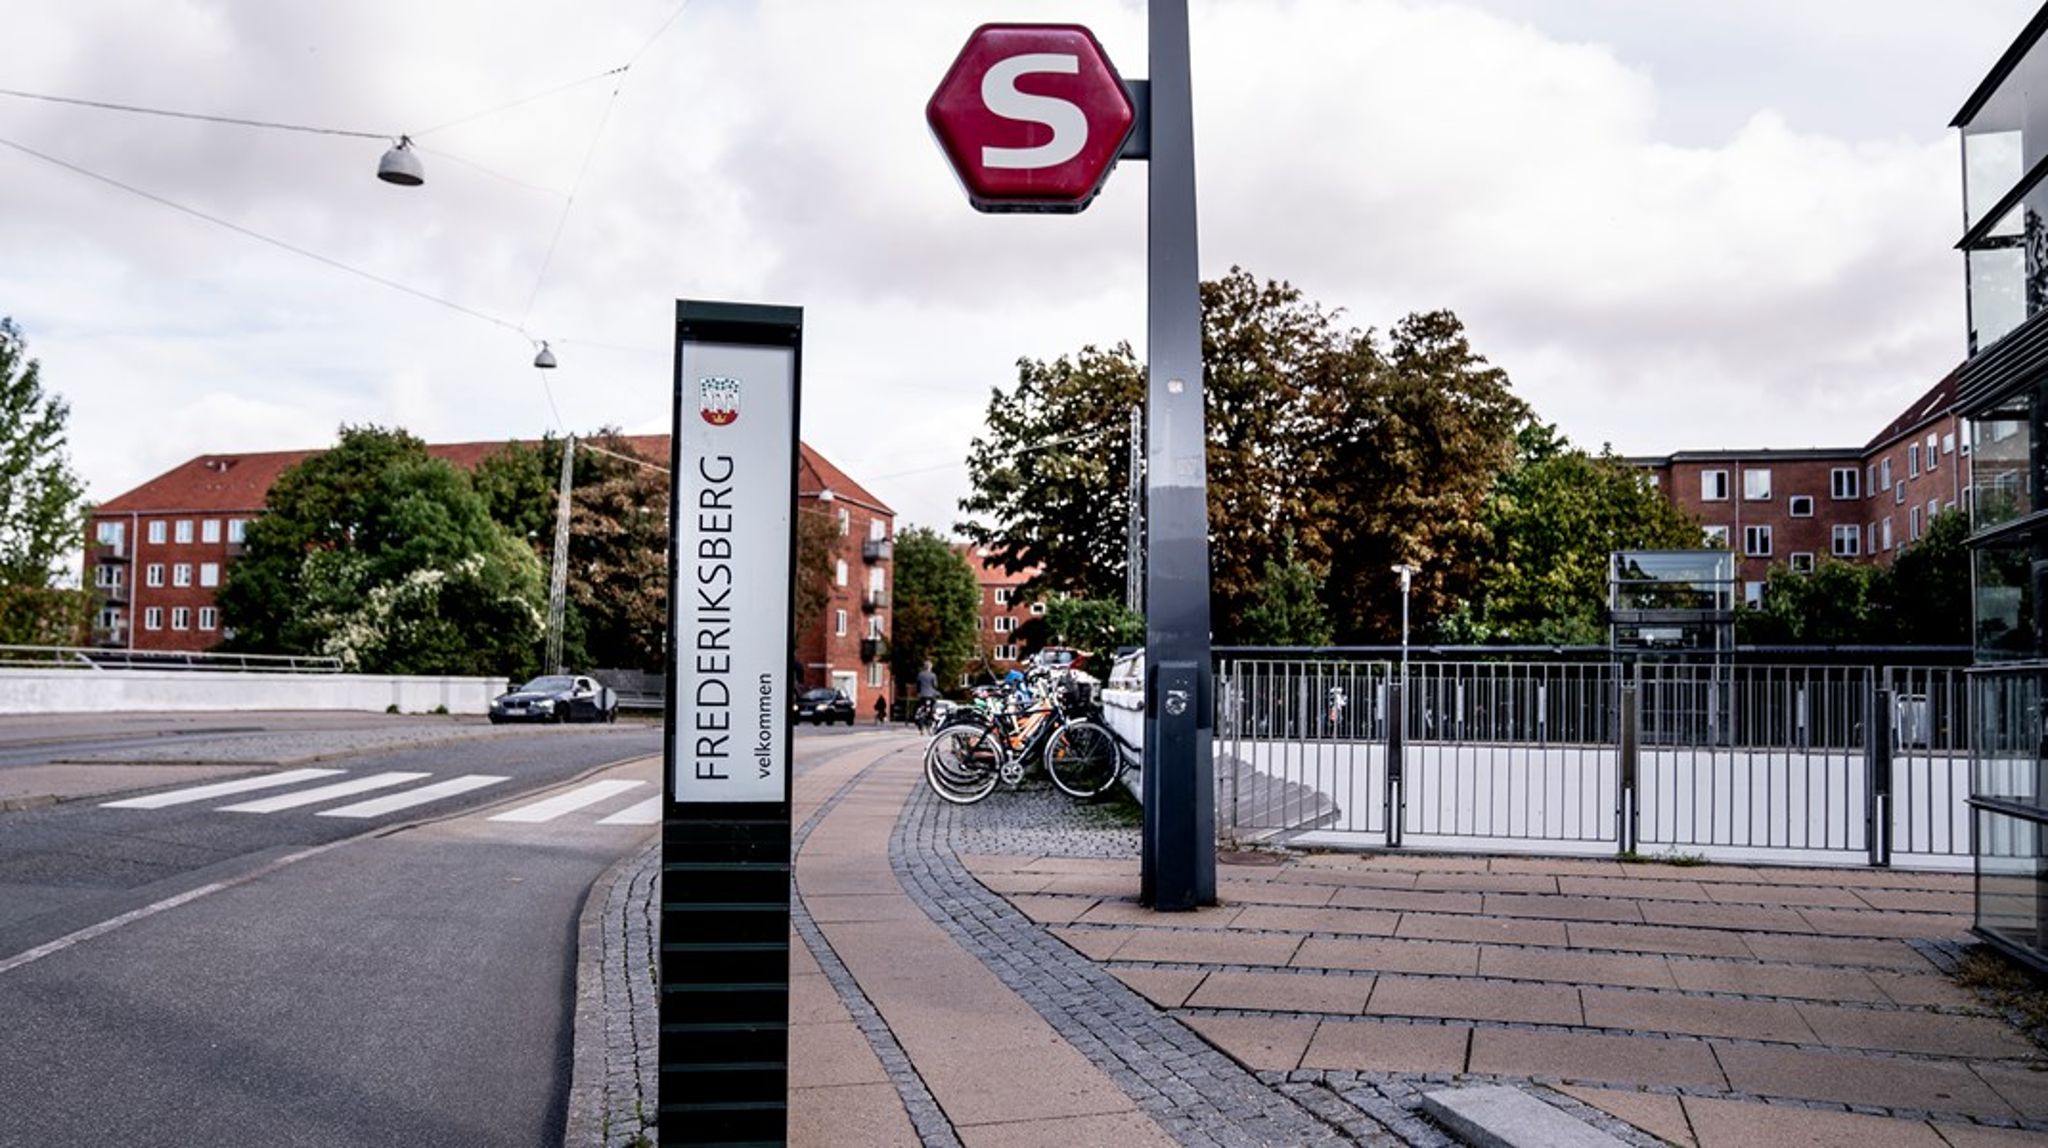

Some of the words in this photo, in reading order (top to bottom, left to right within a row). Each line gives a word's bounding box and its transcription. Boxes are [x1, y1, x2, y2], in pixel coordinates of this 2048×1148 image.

[981, 53, 1088, 169] S
[695, 455, 734, 781] FREDERIKSBERG
[754, 673, 773, 780] velkommen
